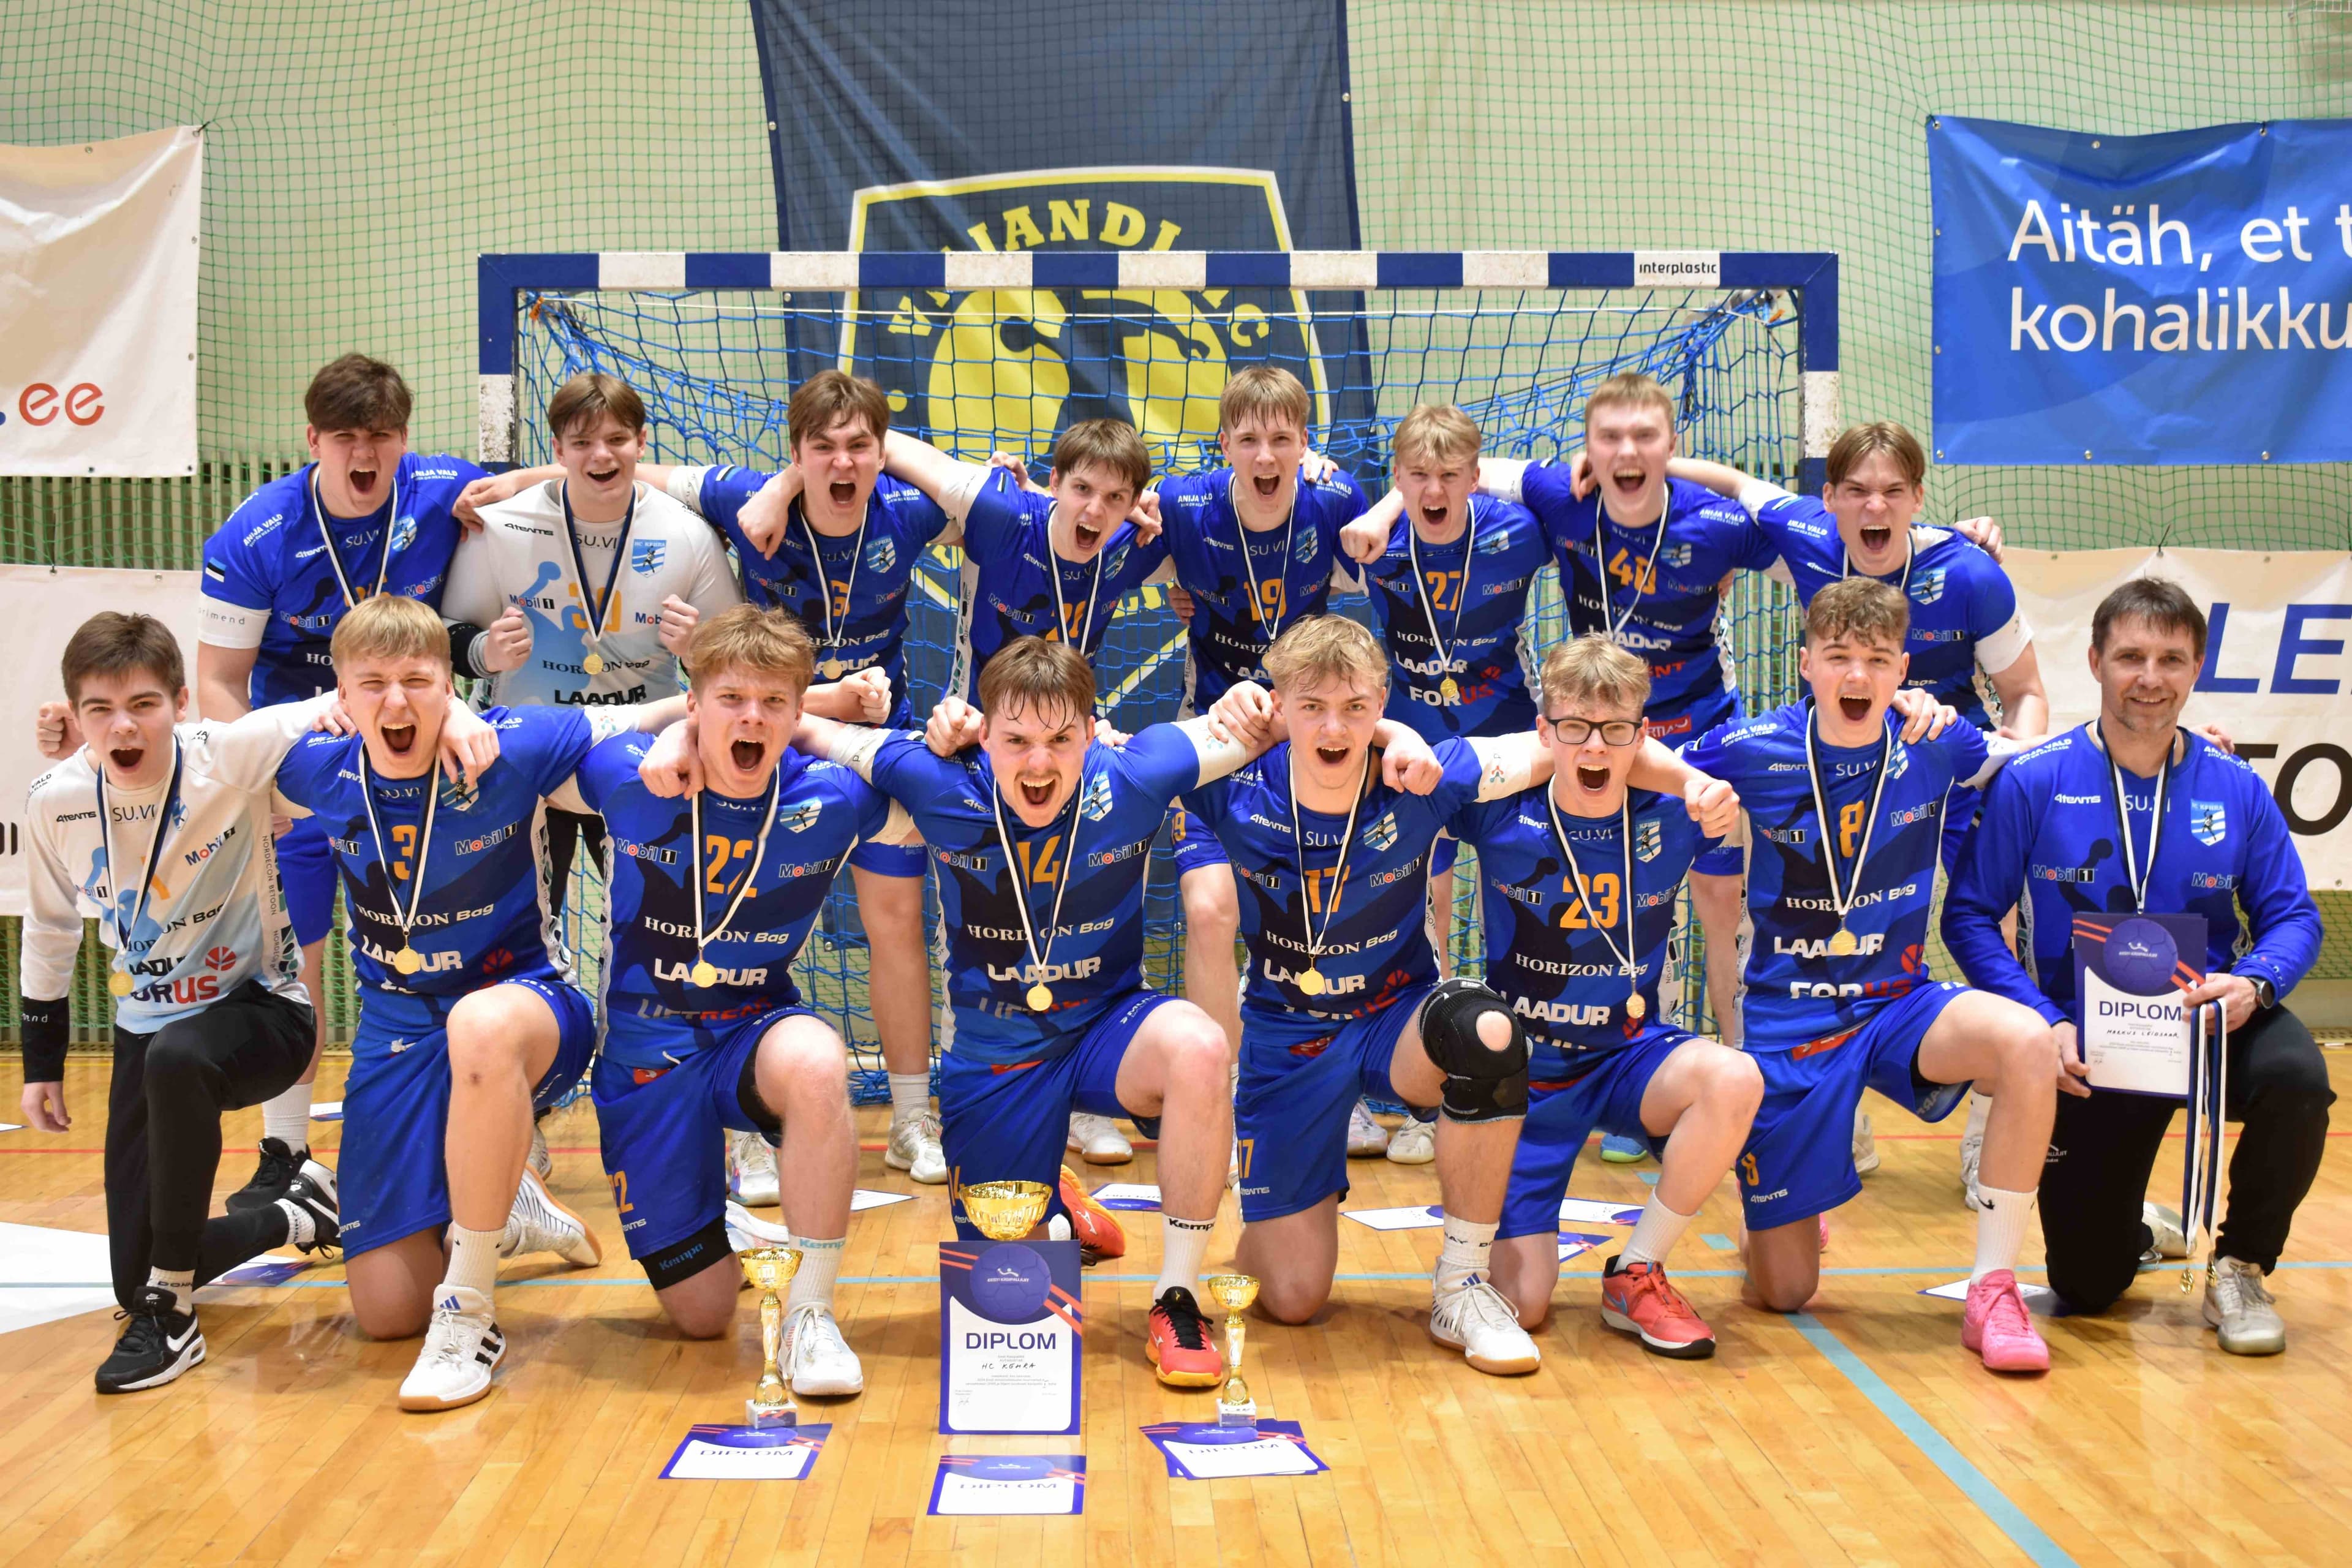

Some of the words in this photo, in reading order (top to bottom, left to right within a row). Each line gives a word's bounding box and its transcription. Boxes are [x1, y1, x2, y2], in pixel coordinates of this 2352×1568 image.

[2008, 198, 2212, 271] Aitäh,
[2241, 203, 2312, 263] et
[1639, 261, 1717, 274] interplastic
[2010, 287, 2352, 352] kohalikku
[436, 469, 458, 477] VALD
[1334, 480, 1352, 494] VALD
[1178, 494, 1200, 503] ANIJA
[260, 514, 283, 530] VALD
[1699, 508, 1722, 520] ANIJA
[1722, 512, 1746, 523] VALD
[1807, 524, 1827, 535] VALD
[750, 569, 783, 594] Mobil
[784, 584, 796, 597] 1
[1368, 572, 1396, 590] Mobil
[1399, 583, 1409, 592] 1
[1426, 570, 1469, 611] 27
[1483, 580, 1514, 595] Mobil
[510, 594, 540, 608] Mobil
[543, 598, 555, 609] 1
[988, 594, 1021, 620] Mobil
[1022, 612, 1035, 624] 1
[1244, 578, 1287, 621] 19
[281, 611, 314, 627] Mobil
[317, 614, 331, 627] 1
[636, 612, 662, 624] Mob
[809, 635, 862, 648] RIZON
[865, 628, 890, 642] Bag
[1215, 632, 1272, 654] HORIZ
[1396, 630, 1468, 647] HORION
[1472, 636, 1497, 647] Bag
[1588, 624, 1672, 650] LADUR
[1912, 628, 1950, 642] Mobil
[1952, 630, 1964, 641] 1
[543, 660, 622, 673] HORON
[555, 685, 647, 705] LAADUR
[1409, 683, 1493, 706] FORUS
[1721, 728, 1748, 745] ANIJA
[1749, 723, 1777, 733] VALD
[2044, 738, 2072, 750] VALD
[1768, 763, 1810, 772] 4team
[113, 805, 155, 822] SU.VI
[1890, 807, 1928, 827] Mobil
[1305, 831, 1347, 847] SU.V
[1789, 830, 1805, 843] 1
[1840, 800, 1865, 858] 8
[347, 840, 360, 856] 1
[456, 830, 503, 856] Mobil
[504, 823, 518, 839] 1
[185, 835, 224, 866] Mobil
[262, 835, 273, 881] NORDECON
[393, 824, 417, 880] 3
[617, 838, 658, 862] Mobil
[660, 849, 677, 865] 1
[930, 843, 969, 869] Mobil
[971, 857, 987, 872] 1
[1088, 844, 1132, 867] Mobil
[1133, 839, 1147, 855] 1
[706, 835, 757, 899] 22
[778, 861, 820, 878] Mobil
[821, 859, 834, 872] 1
[1016, 835, 1069, 892] 14
[1230, 860, 1264, 886] Mobil
[1265, 875, 1280, 889] 1
[1370, 863, 1412, 888] Mobil
[2032, 865, 2075, 883] Mobil
[2078, 868, 2095, 883] 1
[97, 886, 108, 898] 1
[1304, 865, 1351, 913] 17
[1491, 876, 1525, 902] Mobil
[1526, 891, 1542, 905] 1
[1888, 883, 1917, 901] Bag
[1559, 873, 1620, 929] 23
[456, 903, 494, 921] Bag
[644, 916, 750, 943] HORION
[754, 932, 789, 944] Bag
[1079, 917, 1114, 935] Bag
[1366, 929, 1398, 949] Bag
[1774, 933, 1885, 959] LAAUR
[362, 935, 463, 973] LAAUR
[987, 957, 1101, 984] LAADUR
[1515, 953, 1613, 977] HORIZON
[1264, 958, 1365, 995] LAUR
[130, 976, 219, 1005] ORUS
[2099, 1001, 2181, 1021] DIPLOM
[966, 1333, 1056, 1349] DIPLOM
[699, 1449, 794, 1457] DIPLOM
